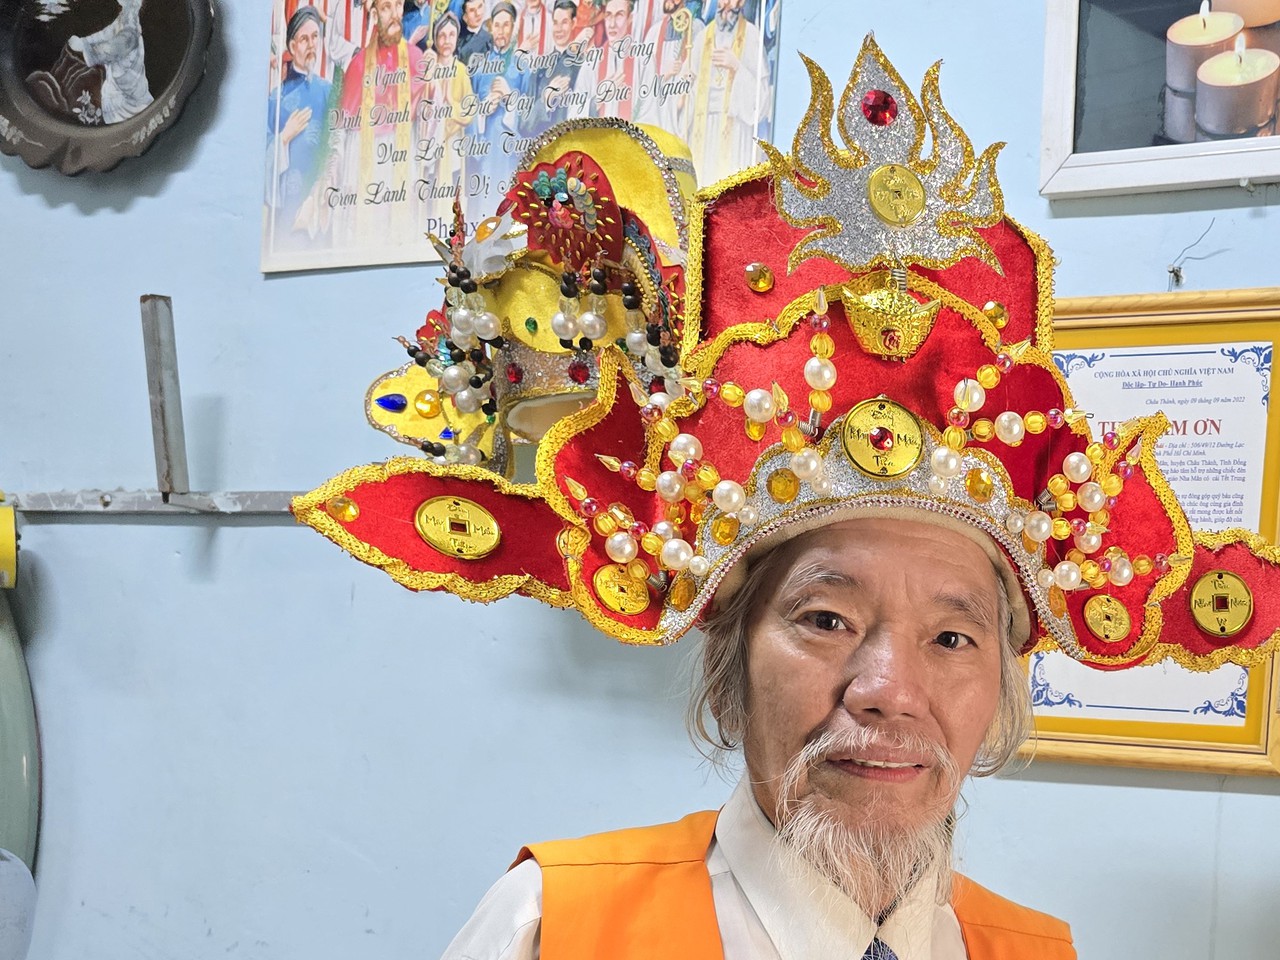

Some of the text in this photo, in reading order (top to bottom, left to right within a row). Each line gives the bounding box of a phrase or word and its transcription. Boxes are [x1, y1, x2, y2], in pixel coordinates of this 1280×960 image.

[640, 73, 694, 108] Người
[376, 142, 408, 167] Vạn
[325, 186, 358, 210] Trọn
[364, 180, 406, 206] Lành
[414, 176, 462, 203] Thánh
[1093, 371, 1114, 379] CỘNG
[1115, 369, 1129, 377] HÒA
[1131, 369, 1141, 377] XÃ
[1142, 369, 1156, 377] HỘI
[1157, 367, 1173, 376] CHỦ
[1173, 367, 1197, 375] NGHĨA
[1198, 367, 1216, 376] VIỆT
[1193, 418, 1222, 436] ƠN
